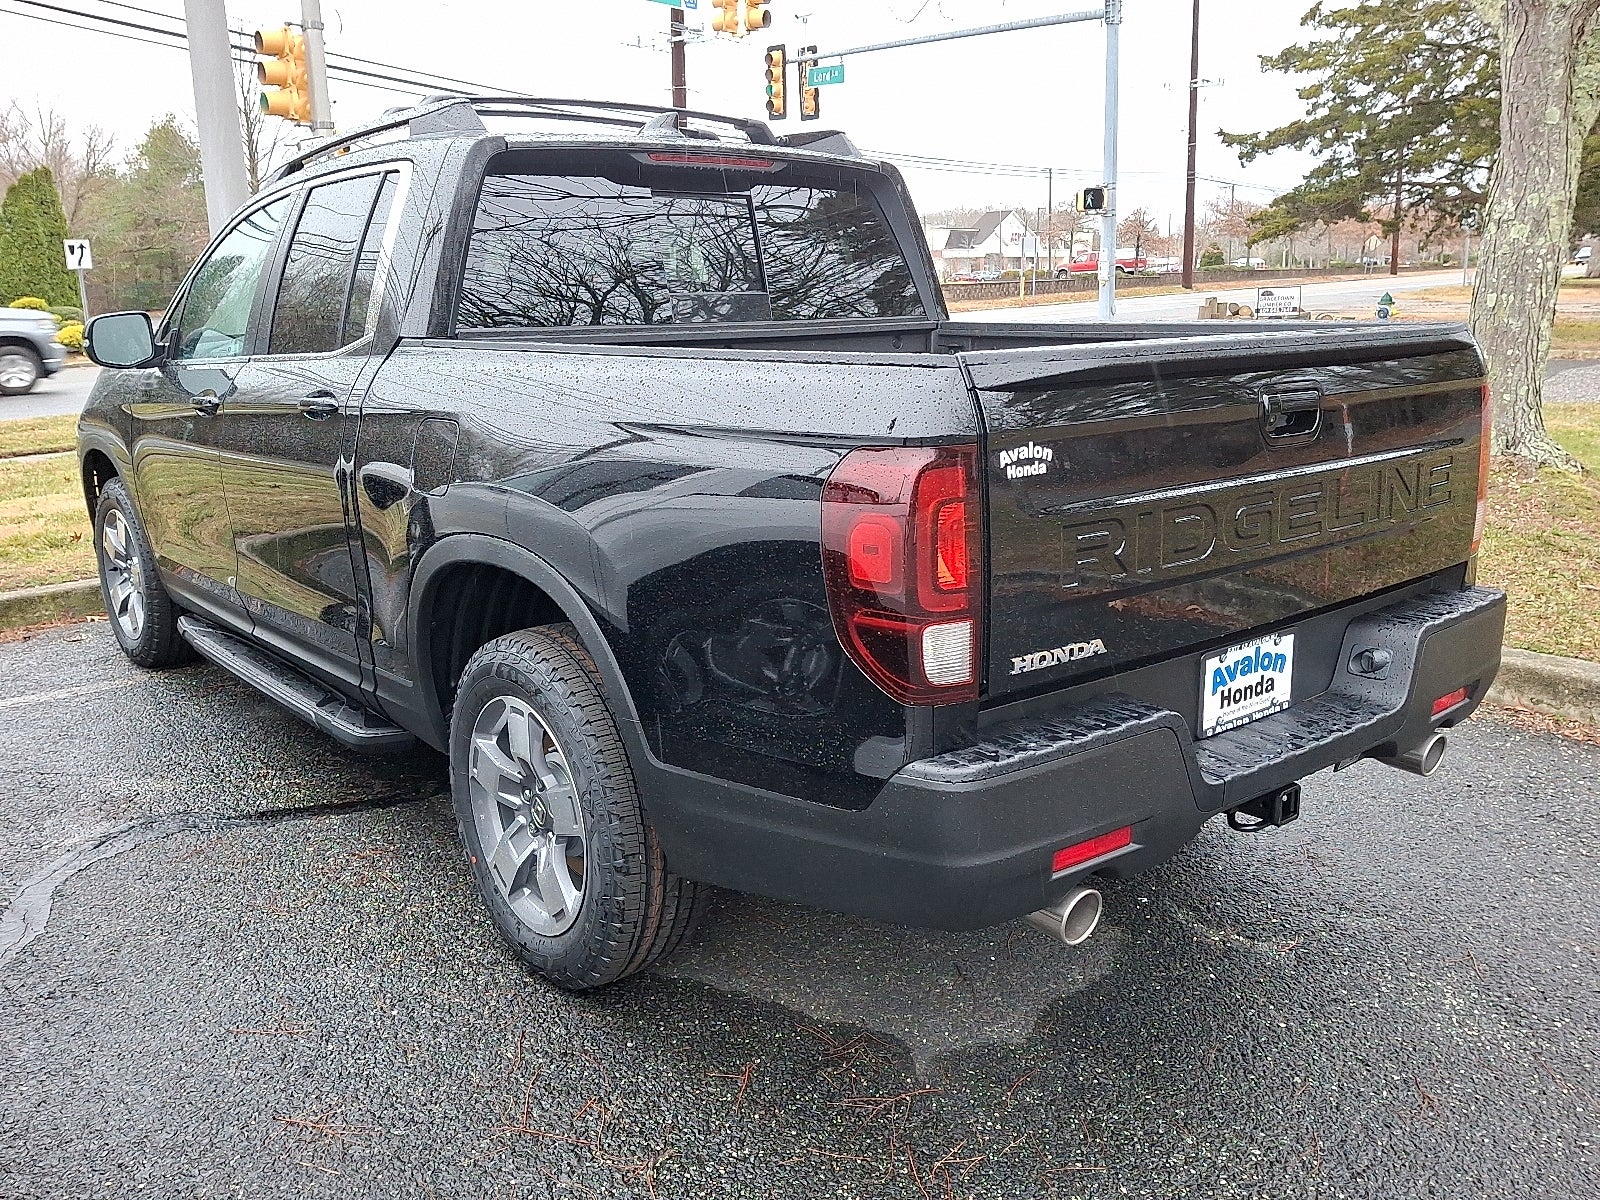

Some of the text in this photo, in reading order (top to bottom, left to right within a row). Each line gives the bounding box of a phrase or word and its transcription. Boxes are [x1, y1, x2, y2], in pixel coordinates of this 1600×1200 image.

[814, 70, 830, 83] Lord
[999, 441, 1053, 469] Avalon
[1006, 461, 1047, 480] Honda
[1061, 455, 1454, 590] RIDGELINE
[1009, 638, 1108, 676] HONDA
[1212, 646, 1286, 696] Avalon
[1220, 674, 1275, 709] Honda
[1214, 704, 1281, 734] Avalon Honda
